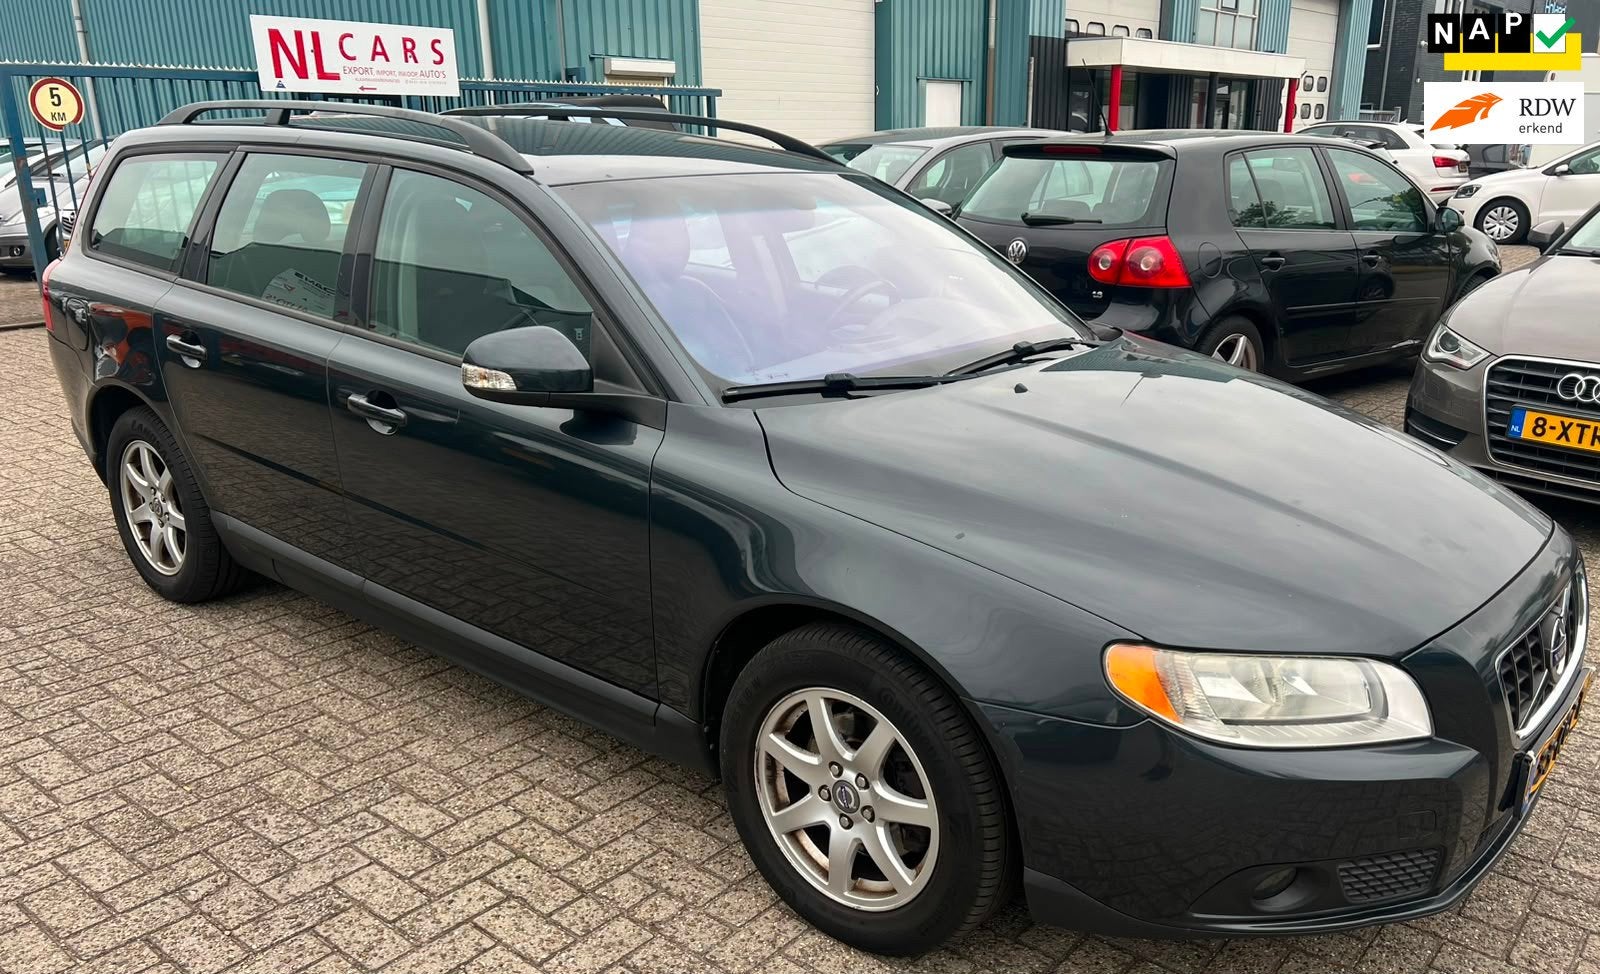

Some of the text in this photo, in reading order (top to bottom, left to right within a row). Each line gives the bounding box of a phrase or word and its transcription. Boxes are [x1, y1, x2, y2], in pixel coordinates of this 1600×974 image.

[267, 28, 445, 80] NL CARS
[49, 87, 62, 107] 5
[51, 112, 67, 121] KM
[1510, 424, 1521, 433] NL
